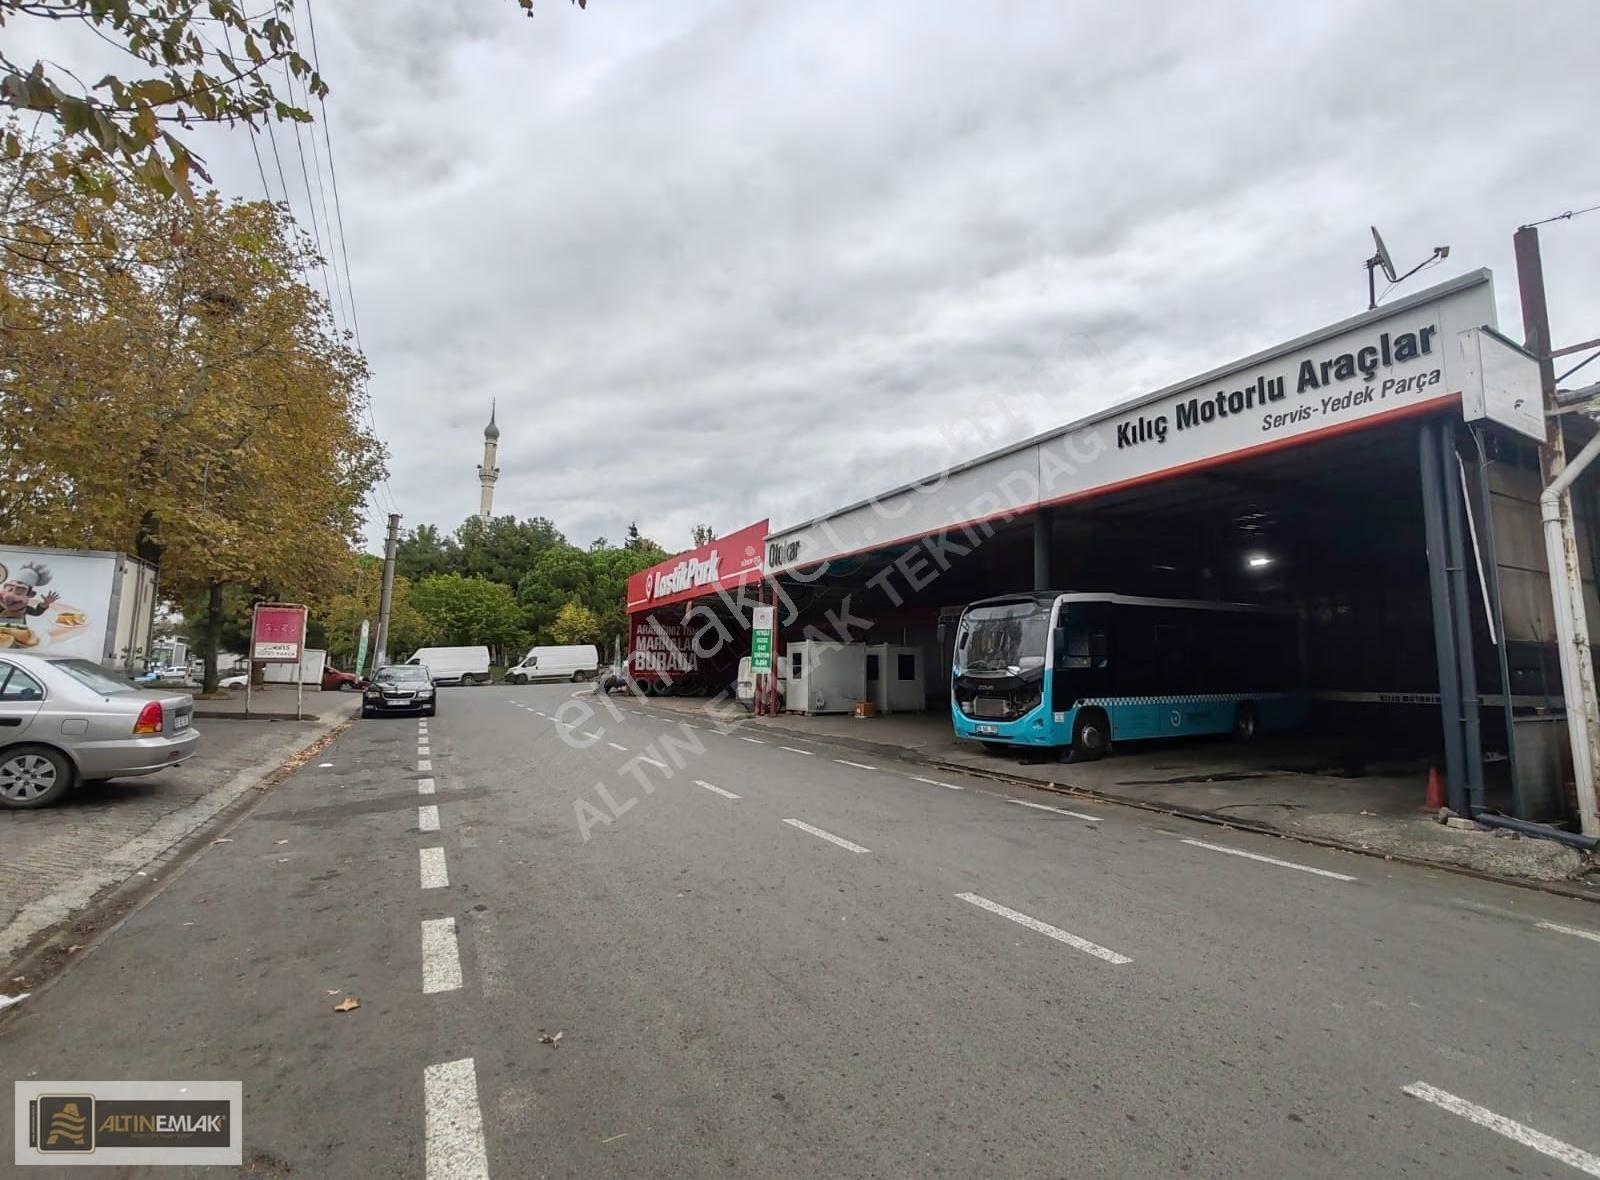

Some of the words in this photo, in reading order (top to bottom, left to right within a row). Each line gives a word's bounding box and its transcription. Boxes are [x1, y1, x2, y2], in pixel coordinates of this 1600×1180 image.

[1117, 414, 1169, 449] Kılıç
[1175, 375, 1287, 431] Motorlu
[1296, 323, 1438, 394] Araçlar
[1262, 386, 1375, 432] Servis-Yedek
[1380, 366, 1441, 399] Parça
[653, 550, 721, 598] LastikPark
[768, 540, 800, 568] Otokar
[634, 651, 699, 671] BURADA
